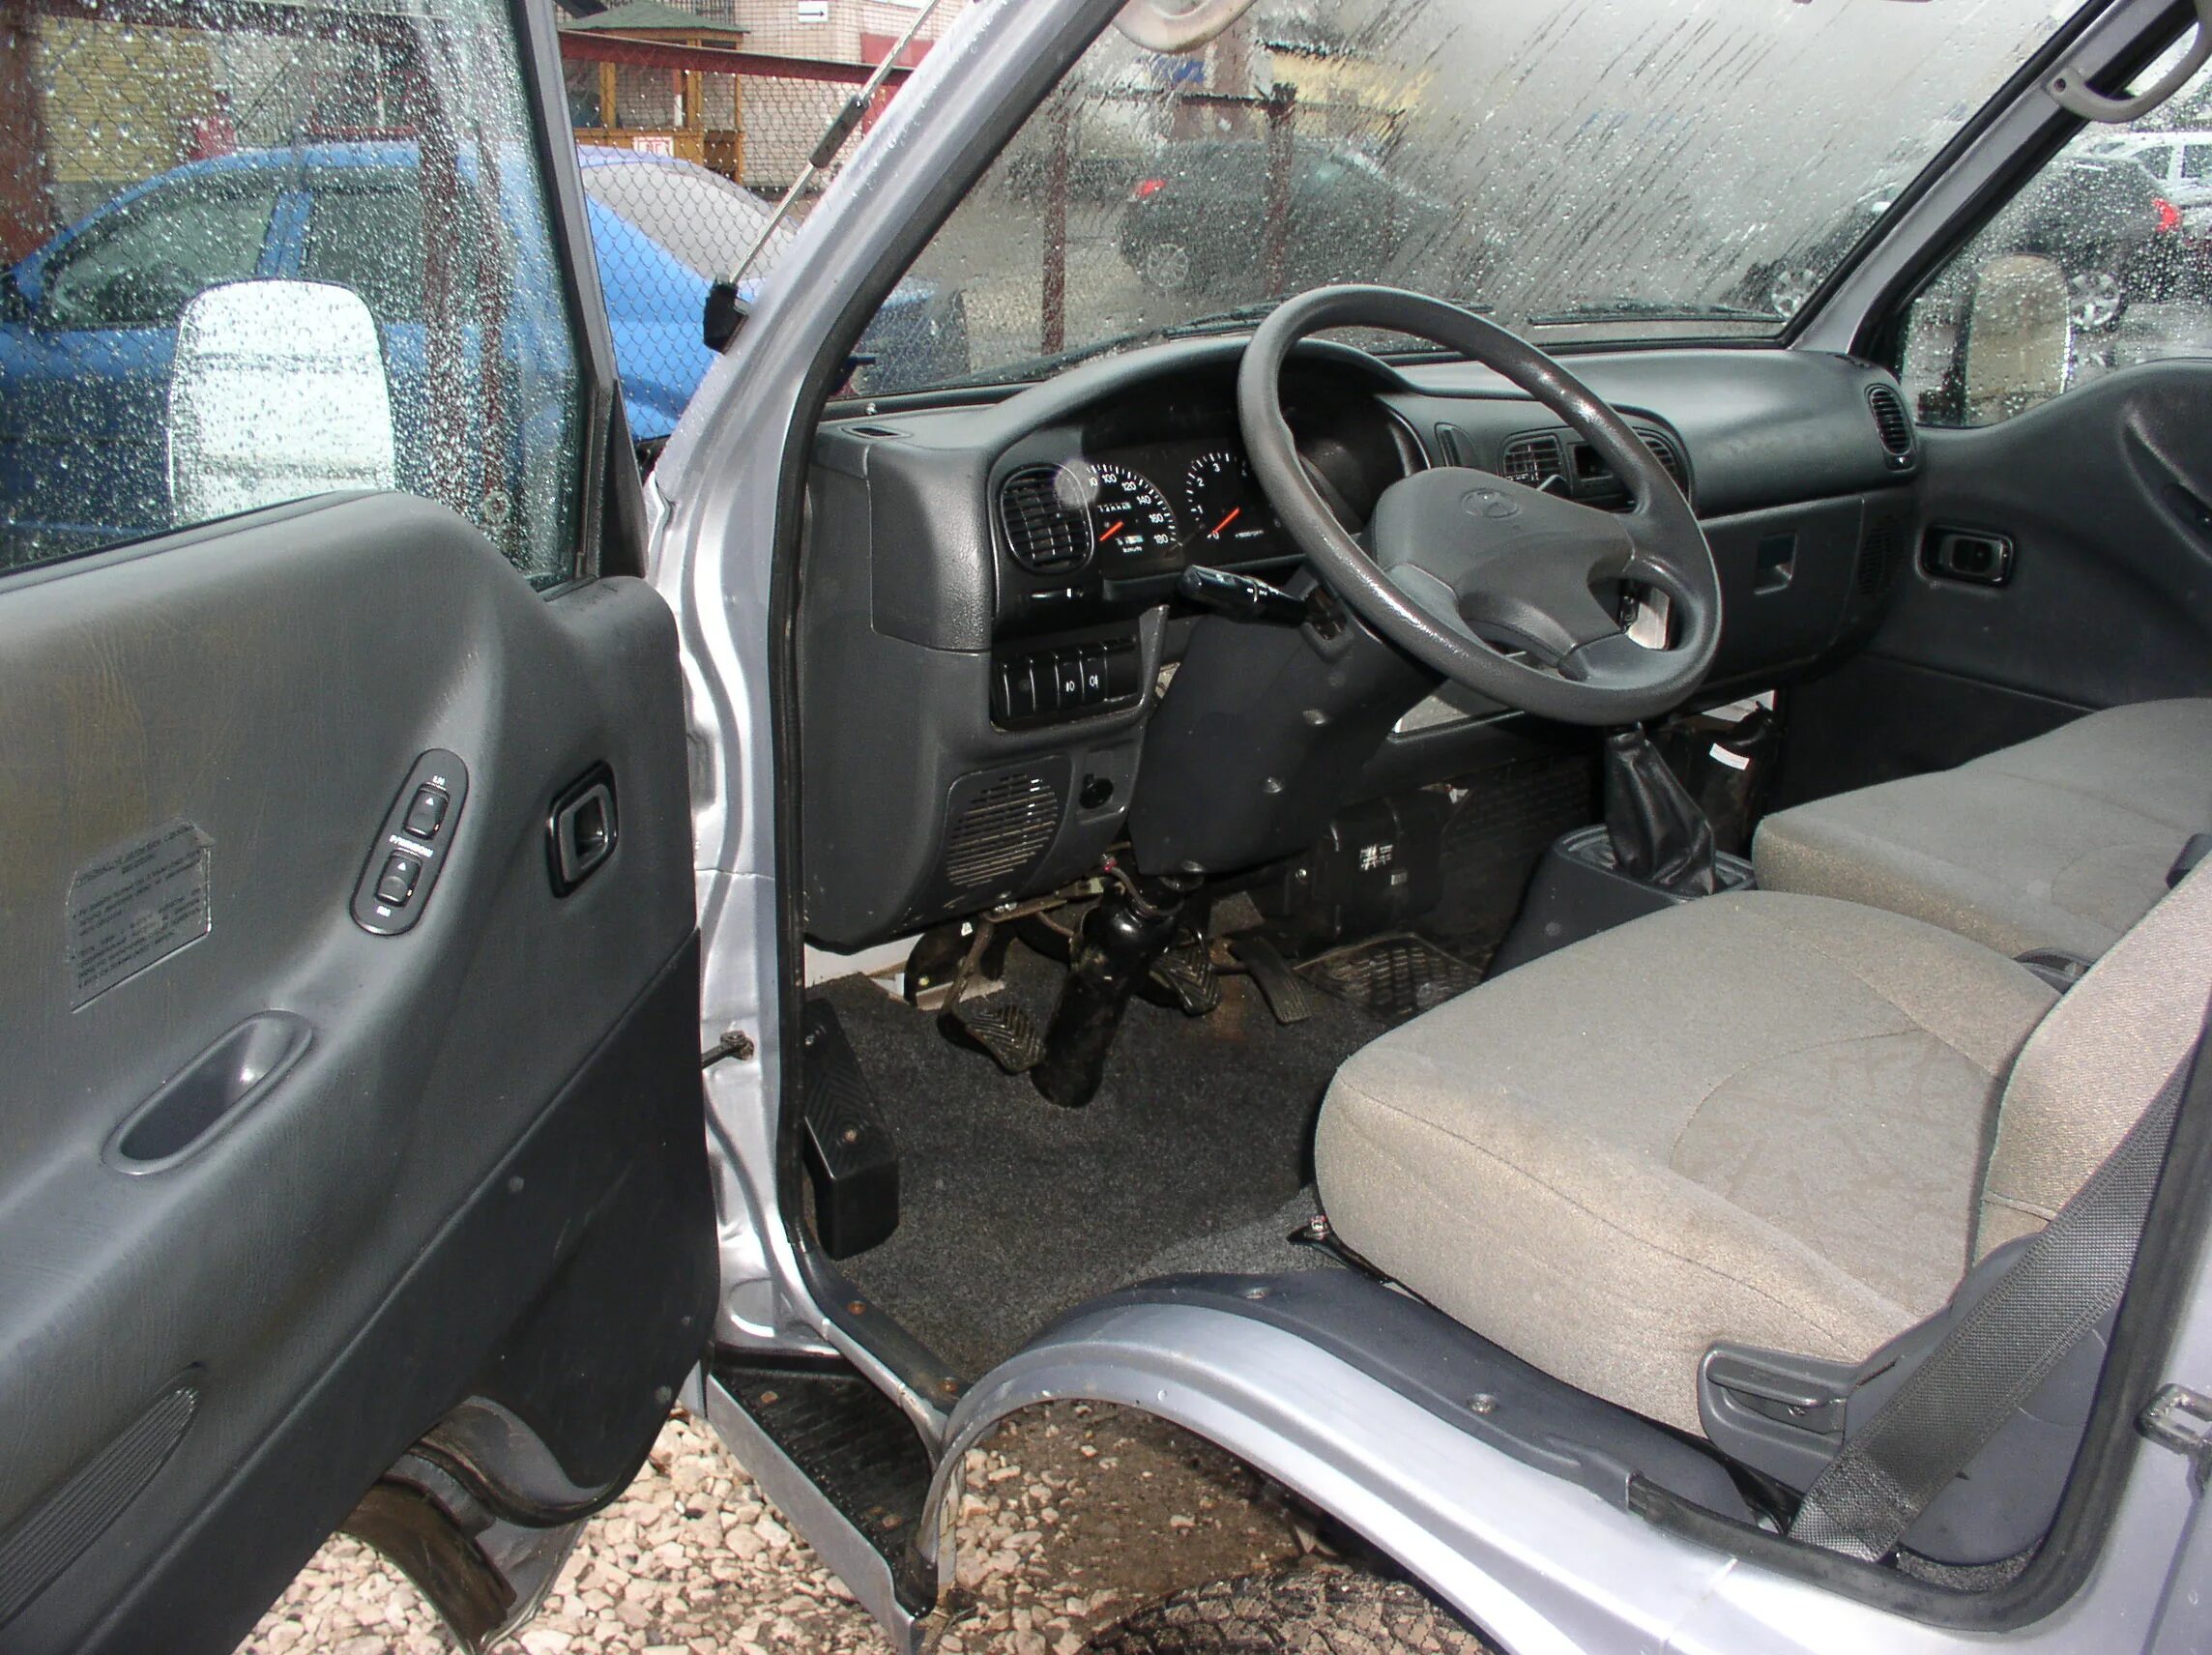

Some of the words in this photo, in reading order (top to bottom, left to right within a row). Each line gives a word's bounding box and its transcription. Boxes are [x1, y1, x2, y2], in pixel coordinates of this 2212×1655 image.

[1212, 463, 1220, 472] 3
[1101, 474, 1118, 483] 100
[1197, 478, 1205, 486] 2
[1121, 481, 1137, 492] 120
[1136, 494, 1152, 506] 140
